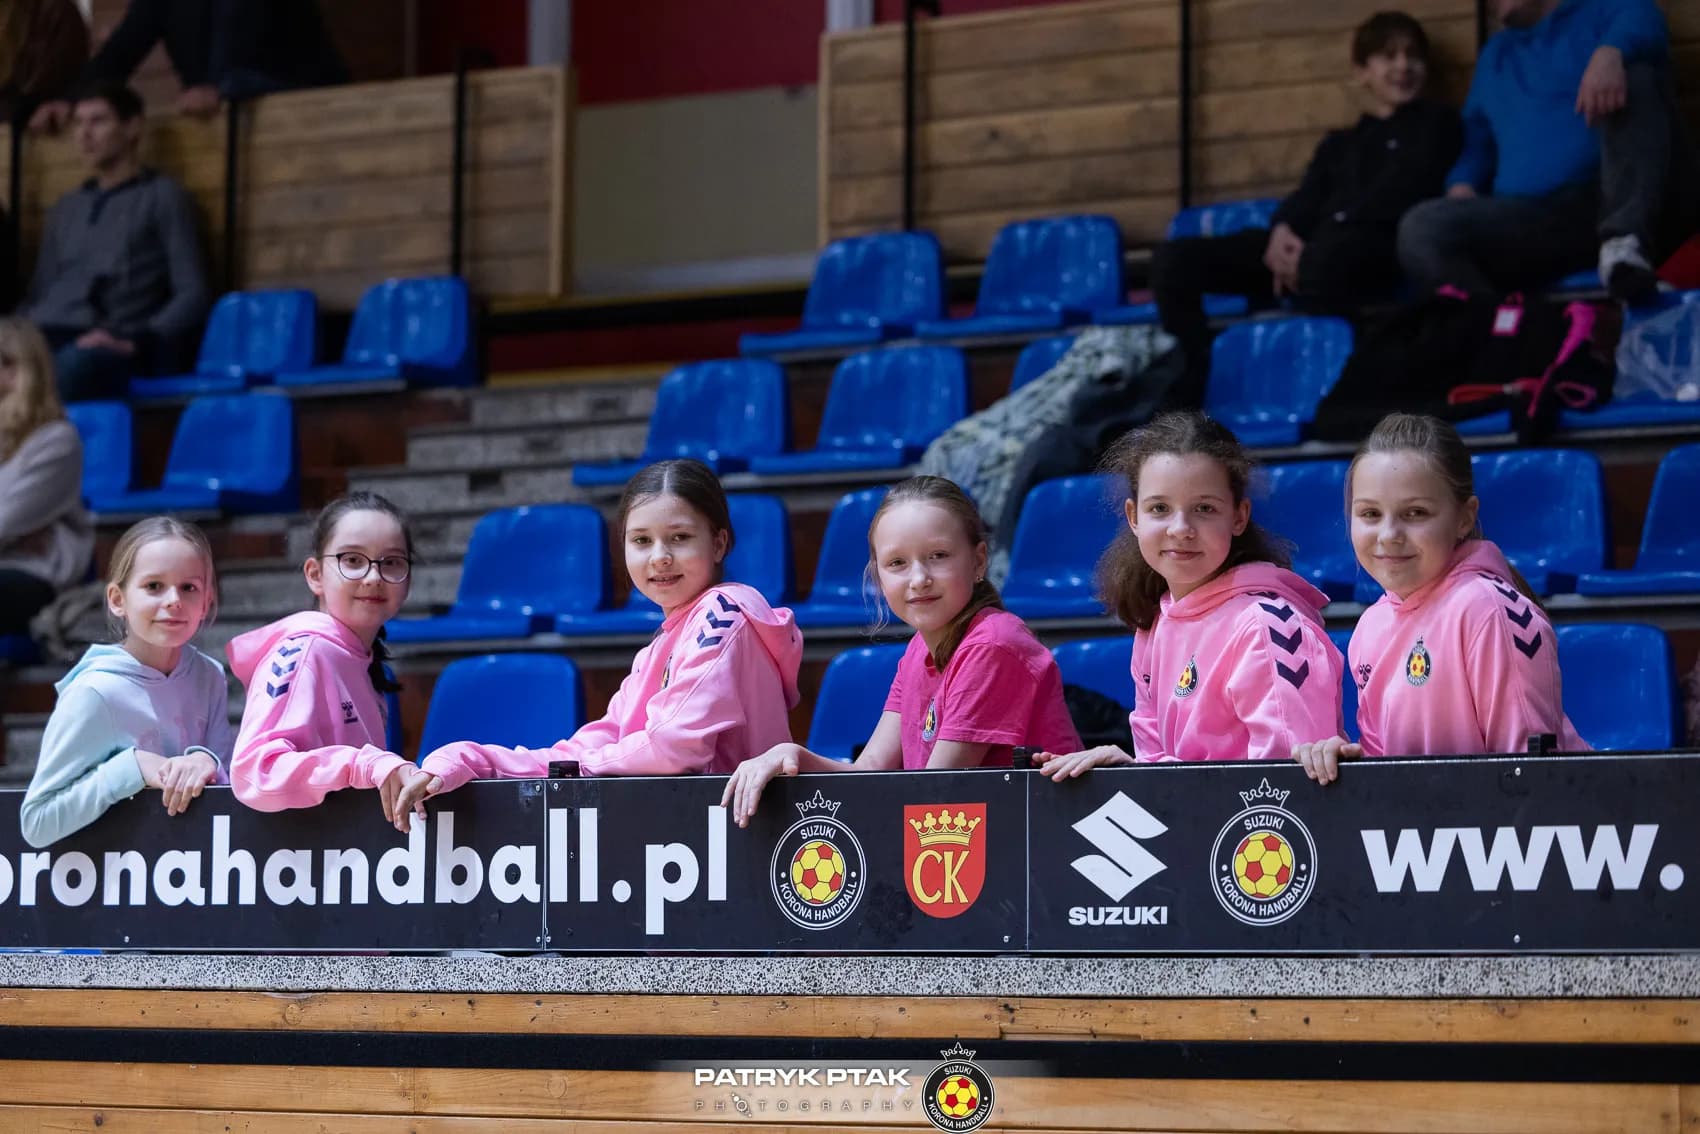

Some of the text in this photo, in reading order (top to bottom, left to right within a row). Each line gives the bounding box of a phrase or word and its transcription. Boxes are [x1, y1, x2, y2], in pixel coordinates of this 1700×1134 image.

[800, 825, 836, 839] SUZUKI
[1244, 815, 1285, 830] SUZUKI
[0, 805, 727, 935] ronahandball.pl
[912, 849, 970, 905] CK
[1361, 824, 1685, 893] www.
[780, 881, 857, 920] KORONA HANDBALL
[1220, 874, 1307, 916] KORONA HANDBALL
[1069, 906, 1167, 925] SUZUKI
